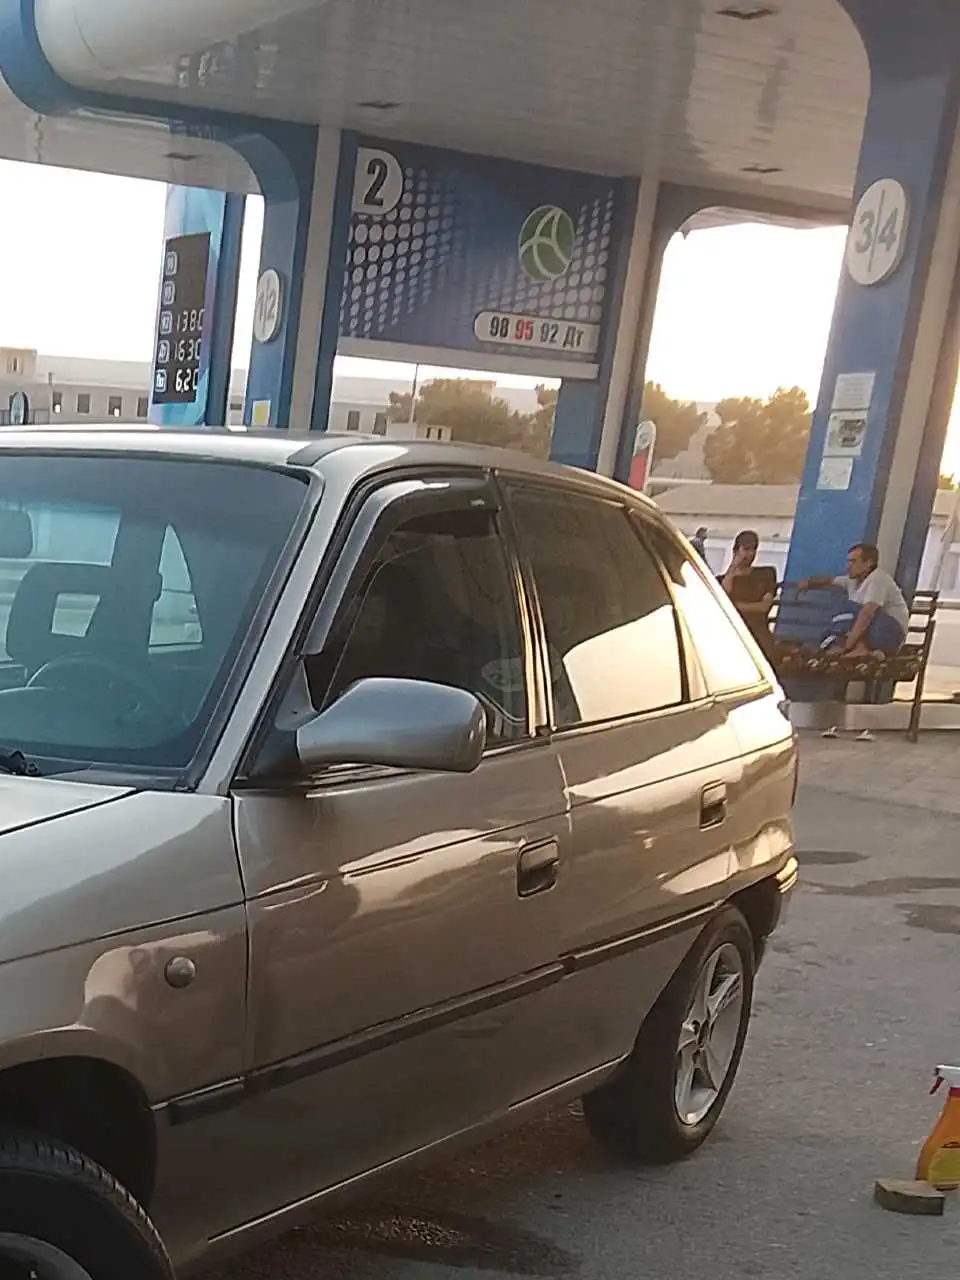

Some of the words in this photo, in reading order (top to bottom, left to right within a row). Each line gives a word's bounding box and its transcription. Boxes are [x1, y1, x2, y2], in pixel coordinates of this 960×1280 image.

[364, 158, 388, 206] 2
[490, 316, 510, 338] 98
[515, 319, 535, 341] 95
[540, 322, 560, 344] 92
